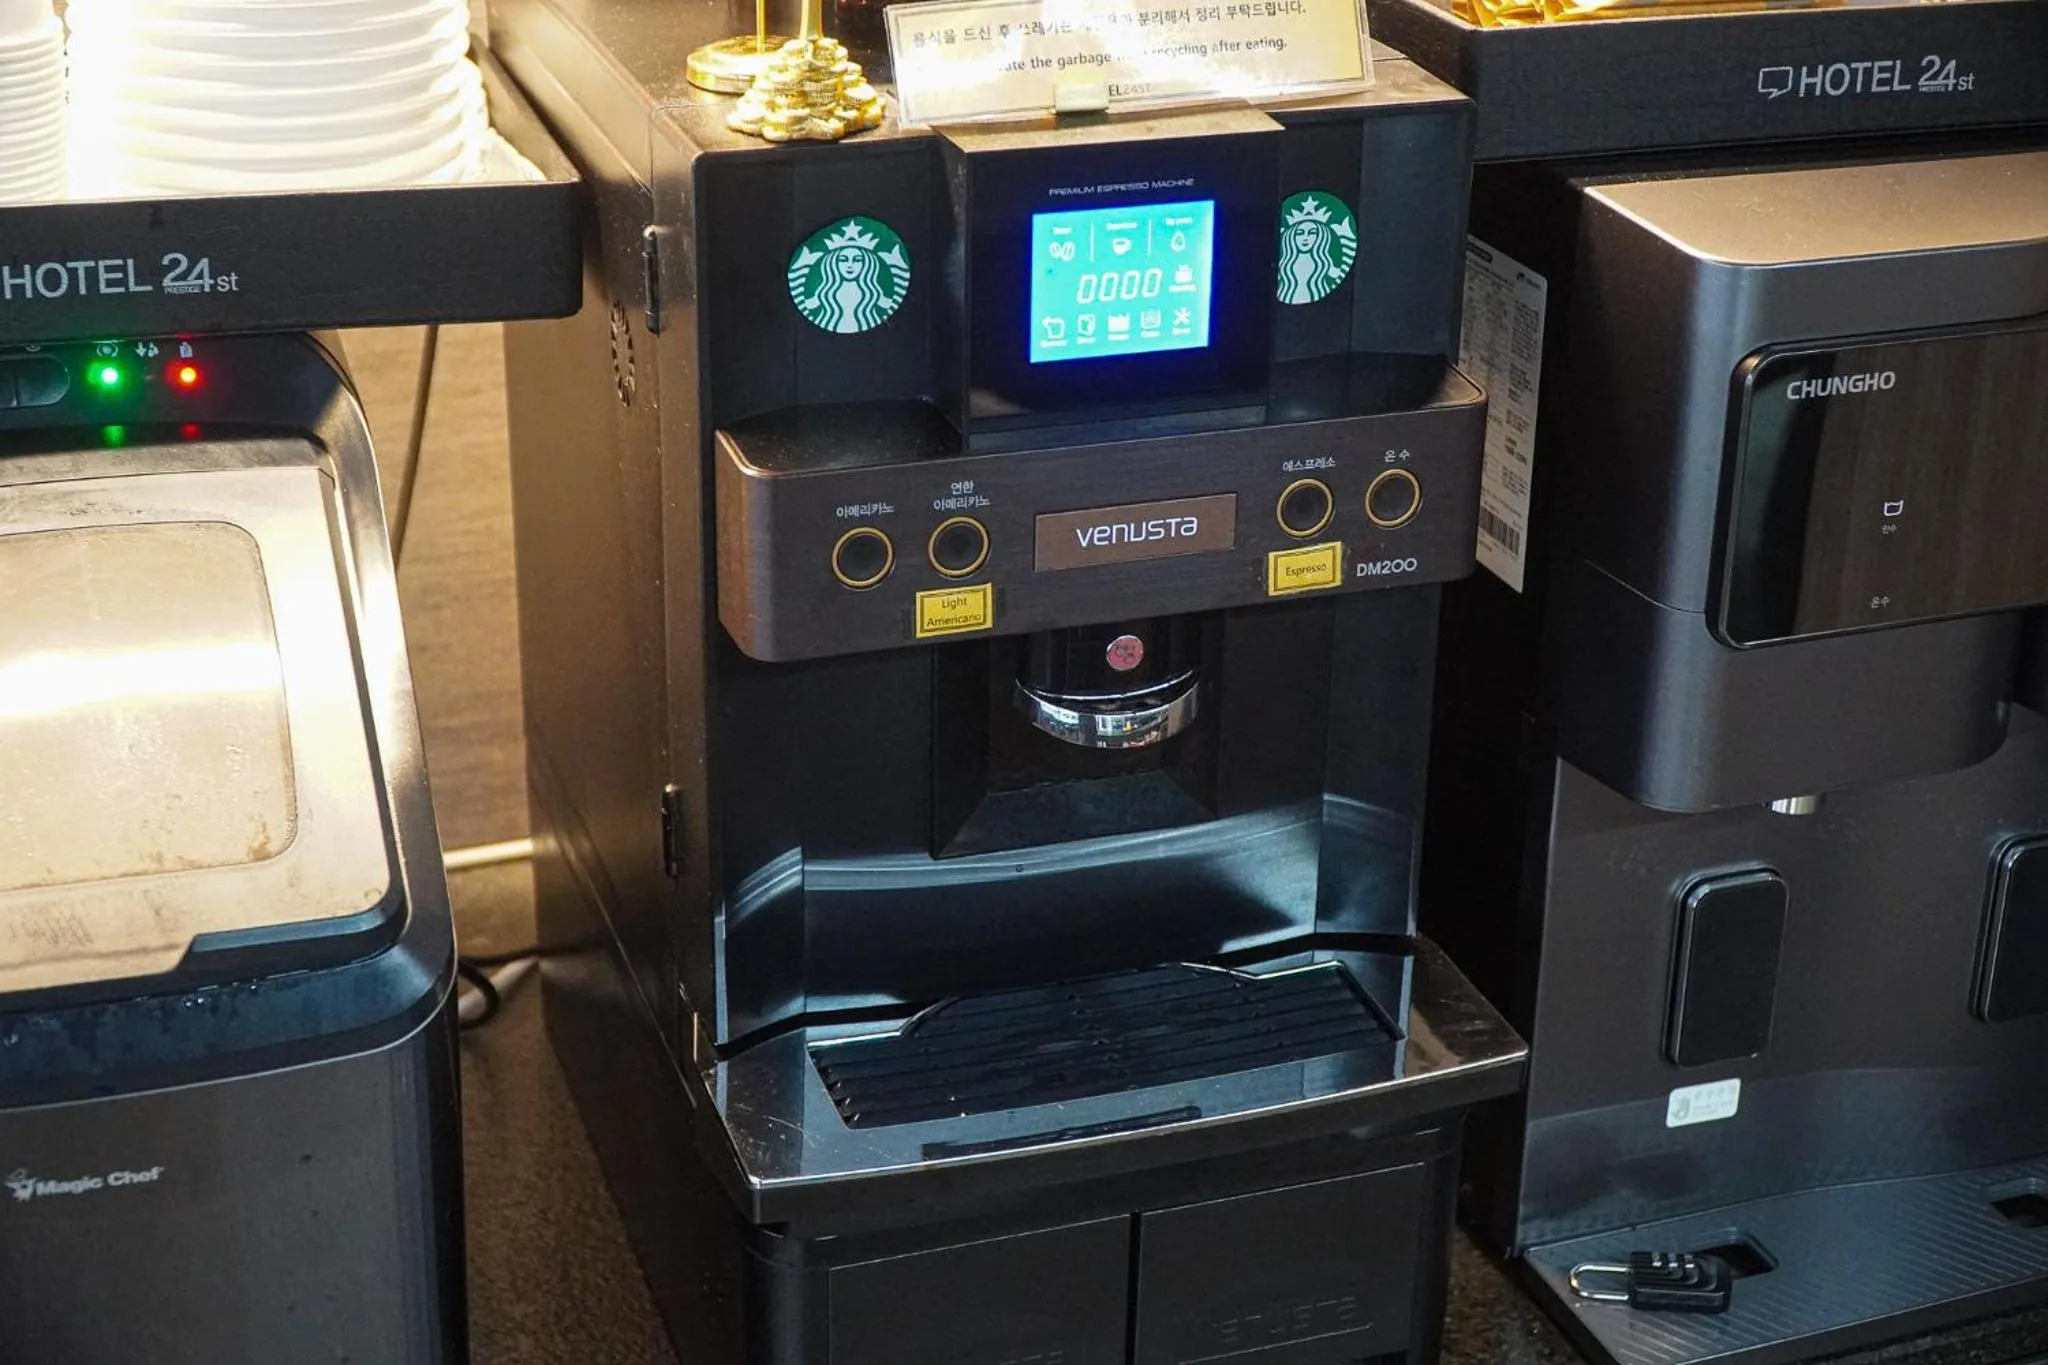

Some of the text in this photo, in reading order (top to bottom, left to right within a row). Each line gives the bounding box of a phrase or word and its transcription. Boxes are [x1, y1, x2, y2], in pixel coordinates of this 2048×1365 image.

[1138, 8, 1190, 26] 분리해서
[1196, 6, 1221, 22] 정리
[1031, 56, 1053, 69] the
[1057, 51, 1112, 70] garbage
[1151, 44, 1208, 57] cycling
[1212, 39, 1241, 52] after
[1245, 36, 1288, 50] eating.
[1798, 60, 1911, 97] HOTEL
[1049, 177, 1196, 197] PREMIUM ESPRESSO MACHINE
[1, 257, 153, 300] HOTEL
[1076, 268, 1163, 304] 0000
[1786, 370, 1896, 400] CHUNGHO
[1282, 456, 1337, 473] 에스프레소
[950, 480, 975, 495] 연한
[836, 501, 895, 519] 아메리카노
[933, 494, 992, 512] 아메리카노
[1285, 562, 1328, 578] Espresso
[1356, 557, 1418, 578] DM200
[941, 596, 968, 609] Light
[926, 613, 982, 628] Americano
[36, 1166, 165, 1197] Magic Chef
